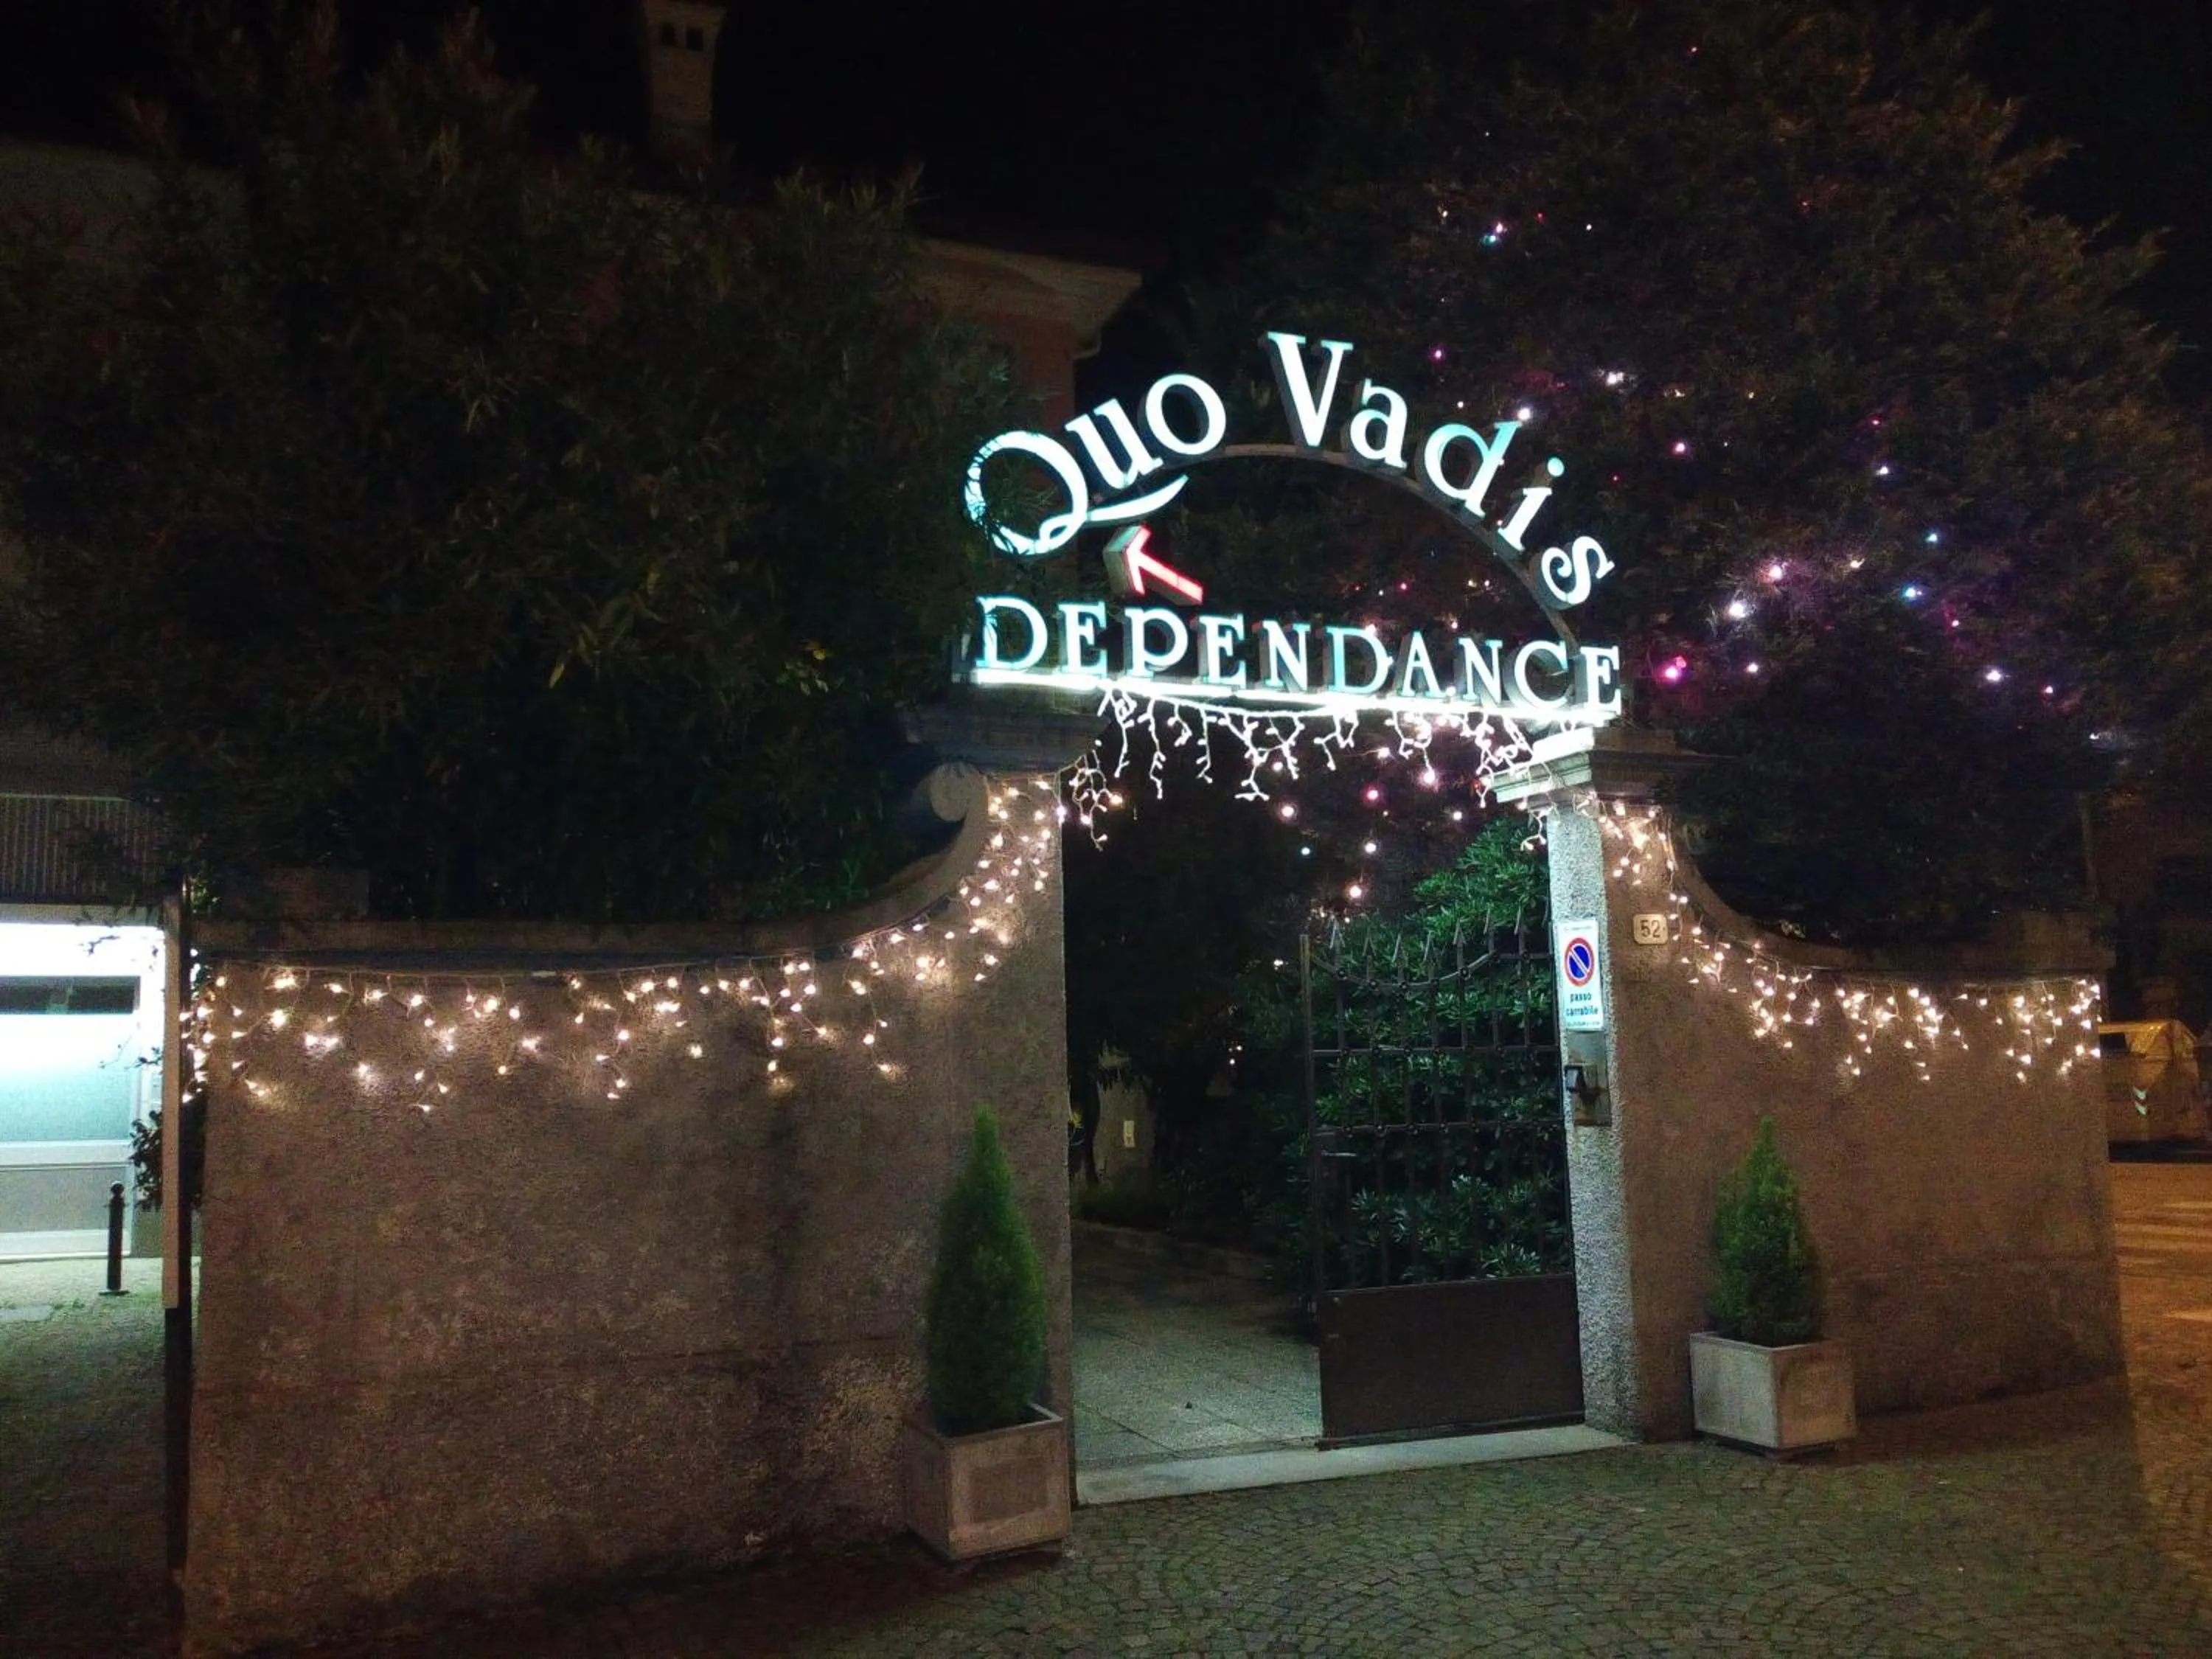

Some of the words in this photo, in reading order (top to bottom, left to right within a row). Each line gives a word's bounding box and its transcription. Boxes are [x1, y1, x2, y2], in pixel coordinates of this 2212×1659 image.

[1265, 330, 1614, 610] Vadis
[975, 595, 1622, 714] DEPENDANCE
[1639, 919, 1660, 938] 52
[1570, 992, 1592, 1003] passo
[1565, 1006, 1599, 1016] carrabile
